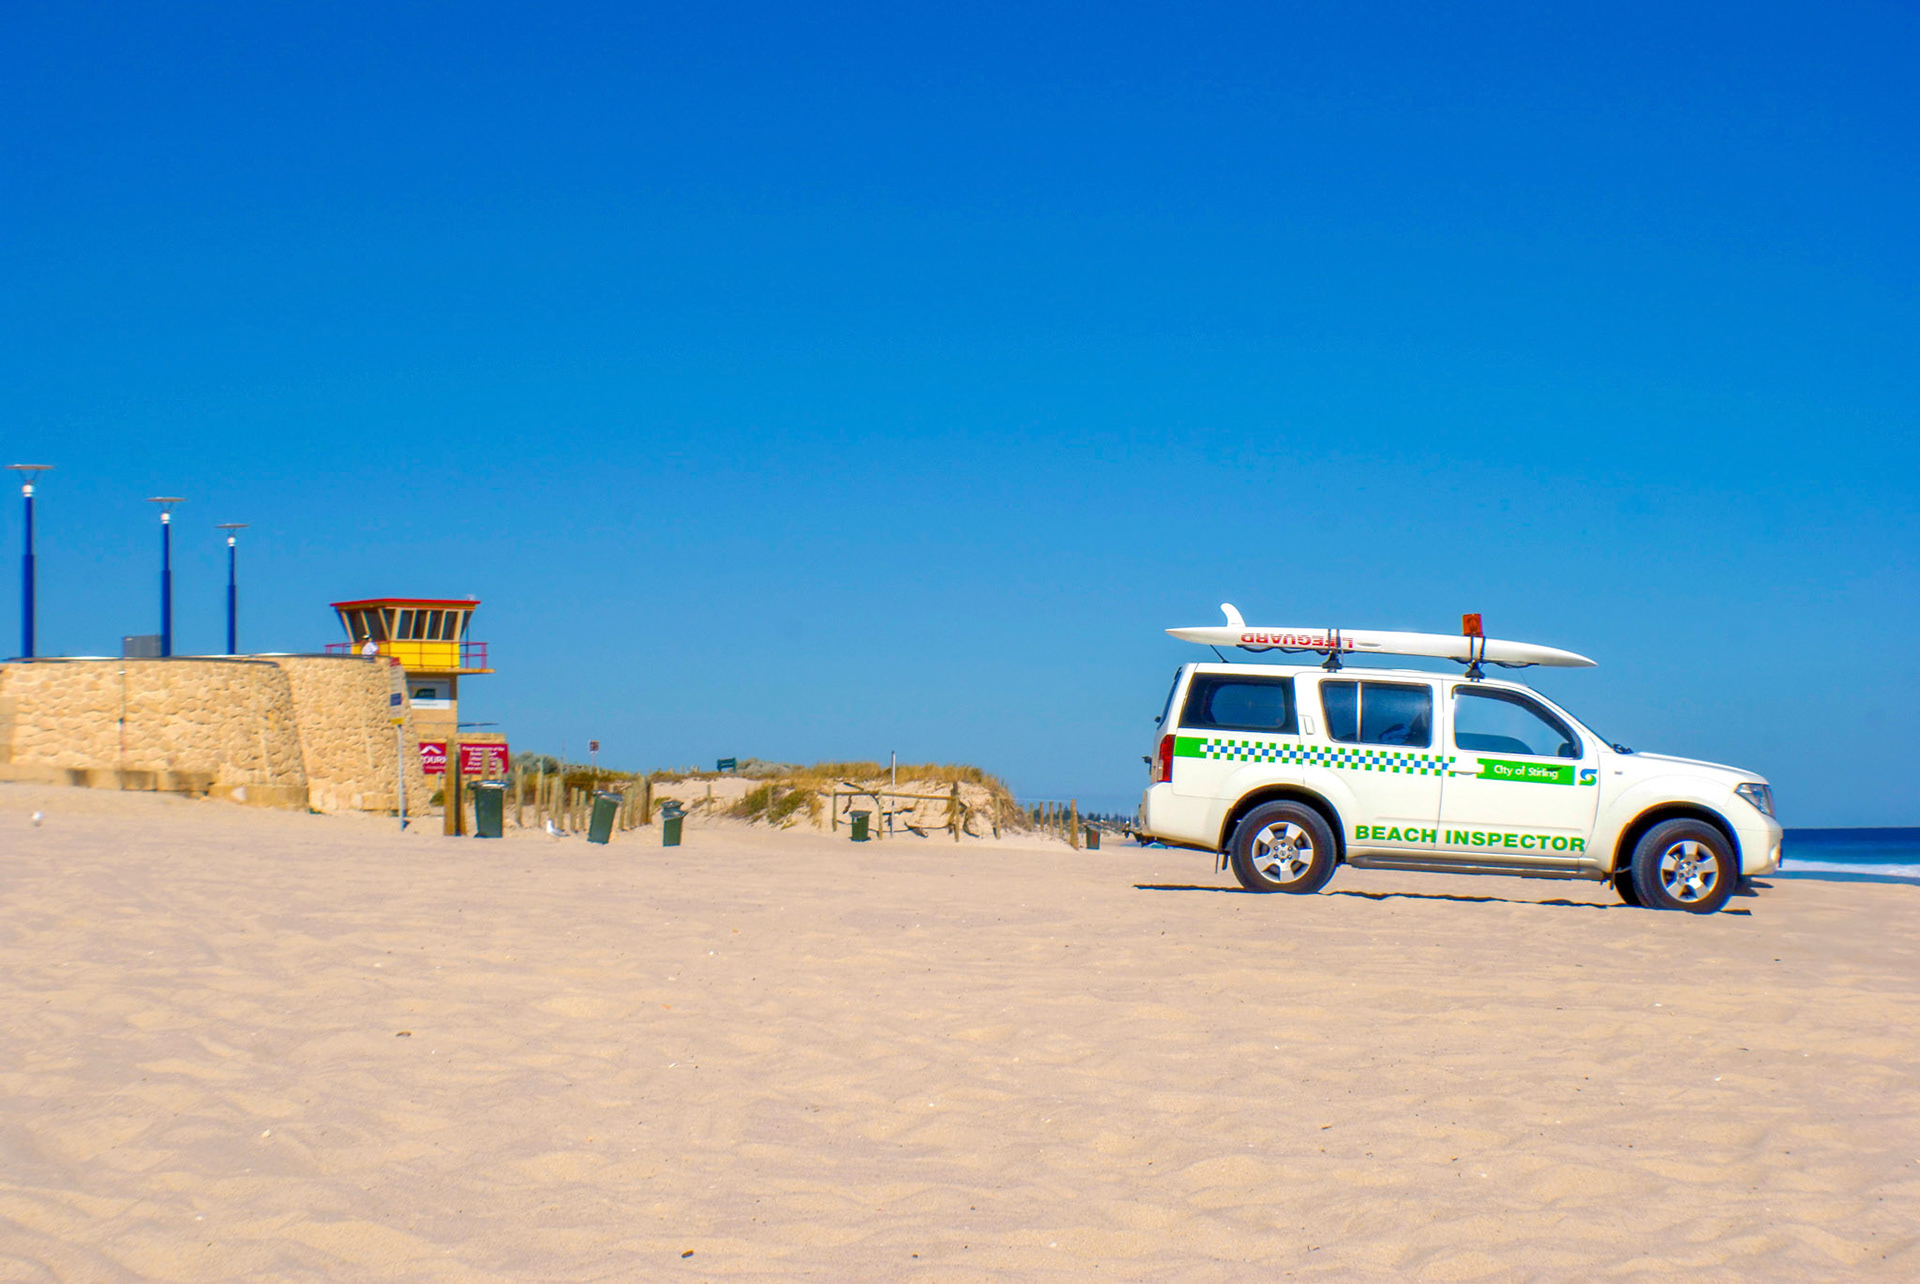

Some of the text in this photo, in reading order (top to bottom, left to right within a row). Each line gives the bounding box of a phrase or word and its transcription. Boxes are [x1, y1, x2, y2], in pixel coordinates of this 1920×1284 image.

[1240, 632, 1354, 649] LFEGUARD
[1493, 764, 1559, 780] City of Stirling
[1354, 825, 1586, 852] BEACH INSPECTOR
